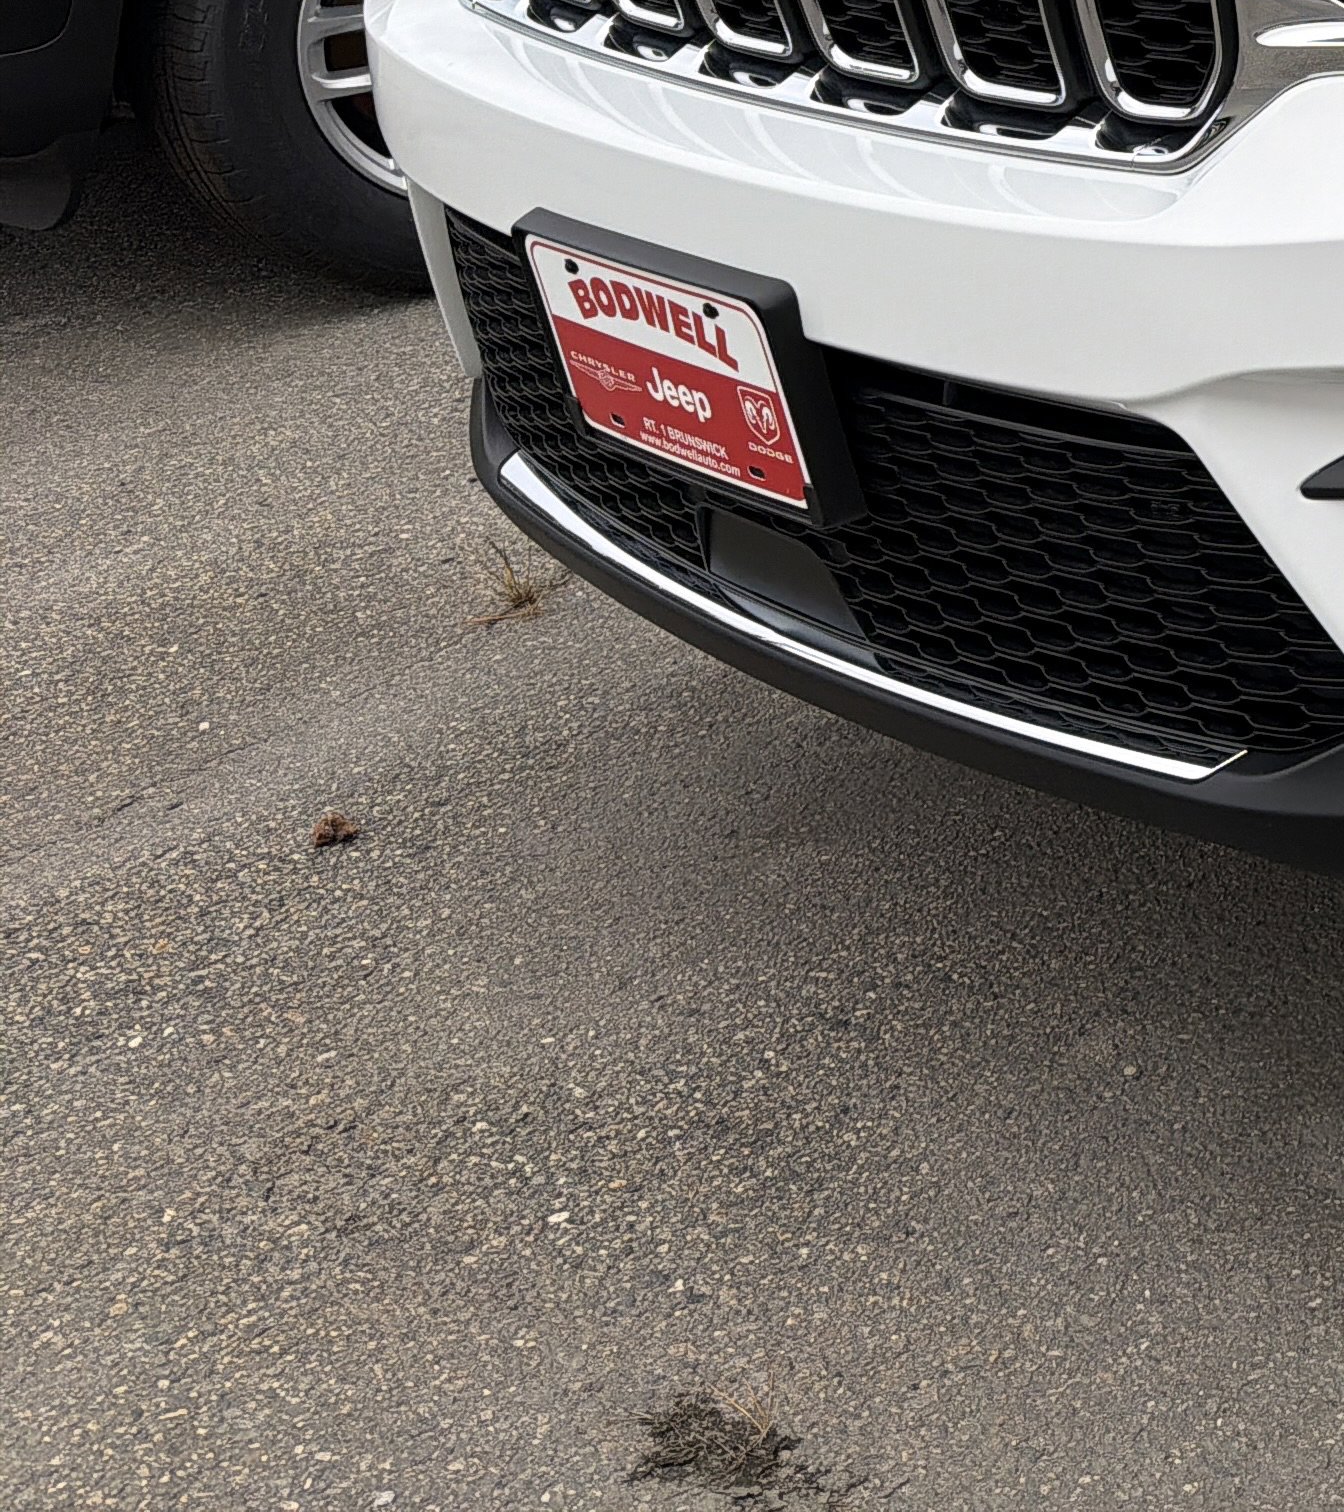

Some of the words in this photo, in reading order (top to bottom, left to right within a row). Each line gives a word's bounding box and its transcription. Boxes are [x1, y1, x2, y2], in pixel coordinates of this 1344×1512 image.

[568, 277, 739, 373] BODWELL
[571, 351, 636, 382] CHRYSLER
[646, 367, 712, 422] Jeep
[640, 430, 741, 478] www.bodwellauto.com
[643, 416, 659, 434] RT.
[667, 426, 729, 460] BRUNSWICK
[748, 442, 794, 464] DODGE
